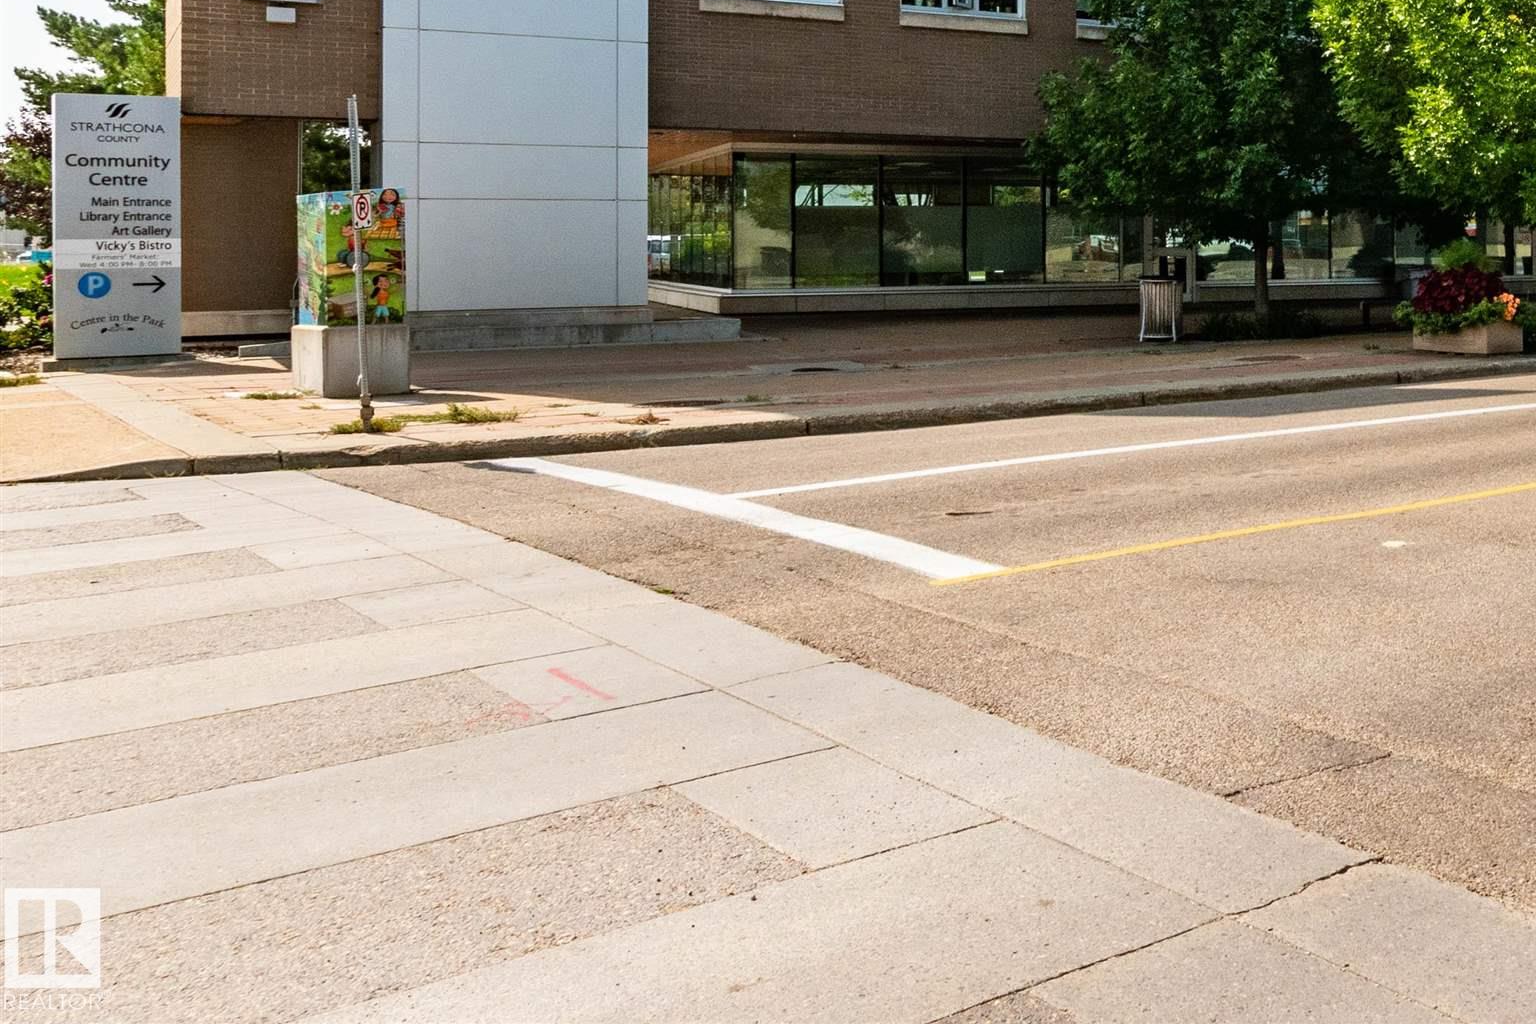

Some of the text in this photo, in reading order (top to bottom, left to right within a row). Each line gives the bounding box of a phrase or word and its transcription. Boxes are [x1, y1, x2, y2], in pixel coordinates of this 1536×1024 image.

[70, 121, 165, 133] STRATHCONA
[97, 135, 140, 143] COUNTY
[65, 153, 171, 171] Community
[89, 173, 148, 186] Centre
[91, 197, 172, 207] Main Entrance
[80, 211, 172, 224] Library Entrance
[112, 226, 172, 238] Art Gallery
[96, 241, 172, 252] Vicky's Bistro
[70, 313, 166, 330] Centre in the Park
